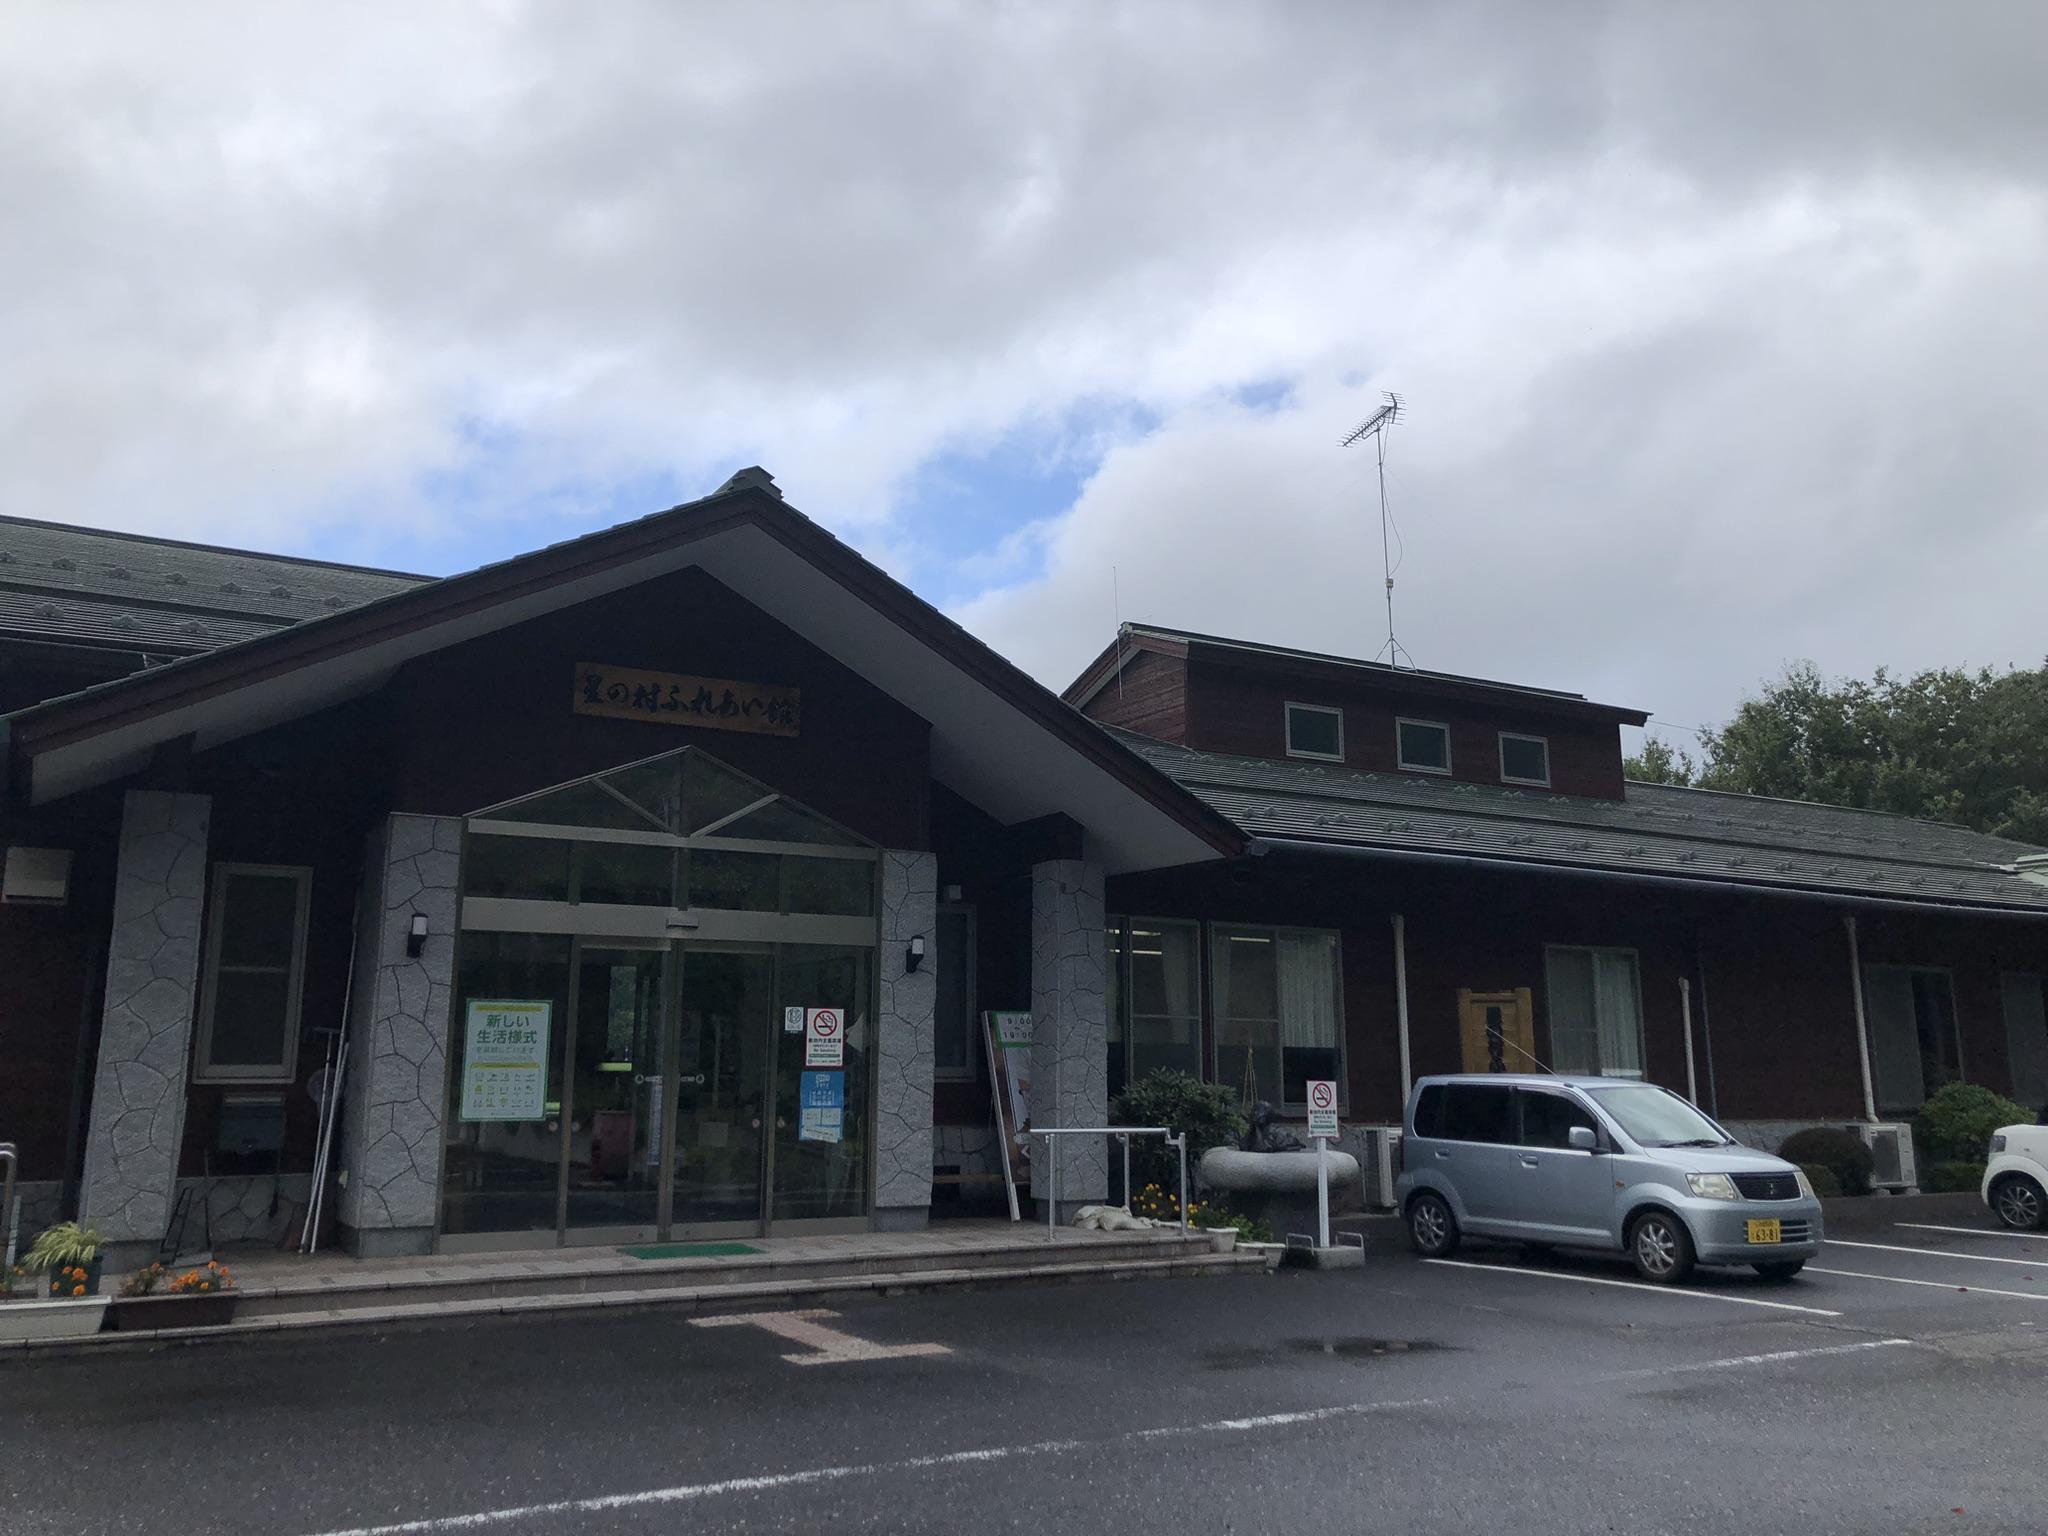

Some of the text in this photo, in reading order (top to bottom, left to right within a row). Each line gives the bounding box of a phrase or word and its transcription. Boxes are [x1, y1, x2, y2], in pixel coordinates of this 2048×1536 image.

[486, 1014, 530, 1028] 新しい
[476, 1029, 537, 1044] 生活様式
[1756, 1228, 1778, 1241] 63-81
